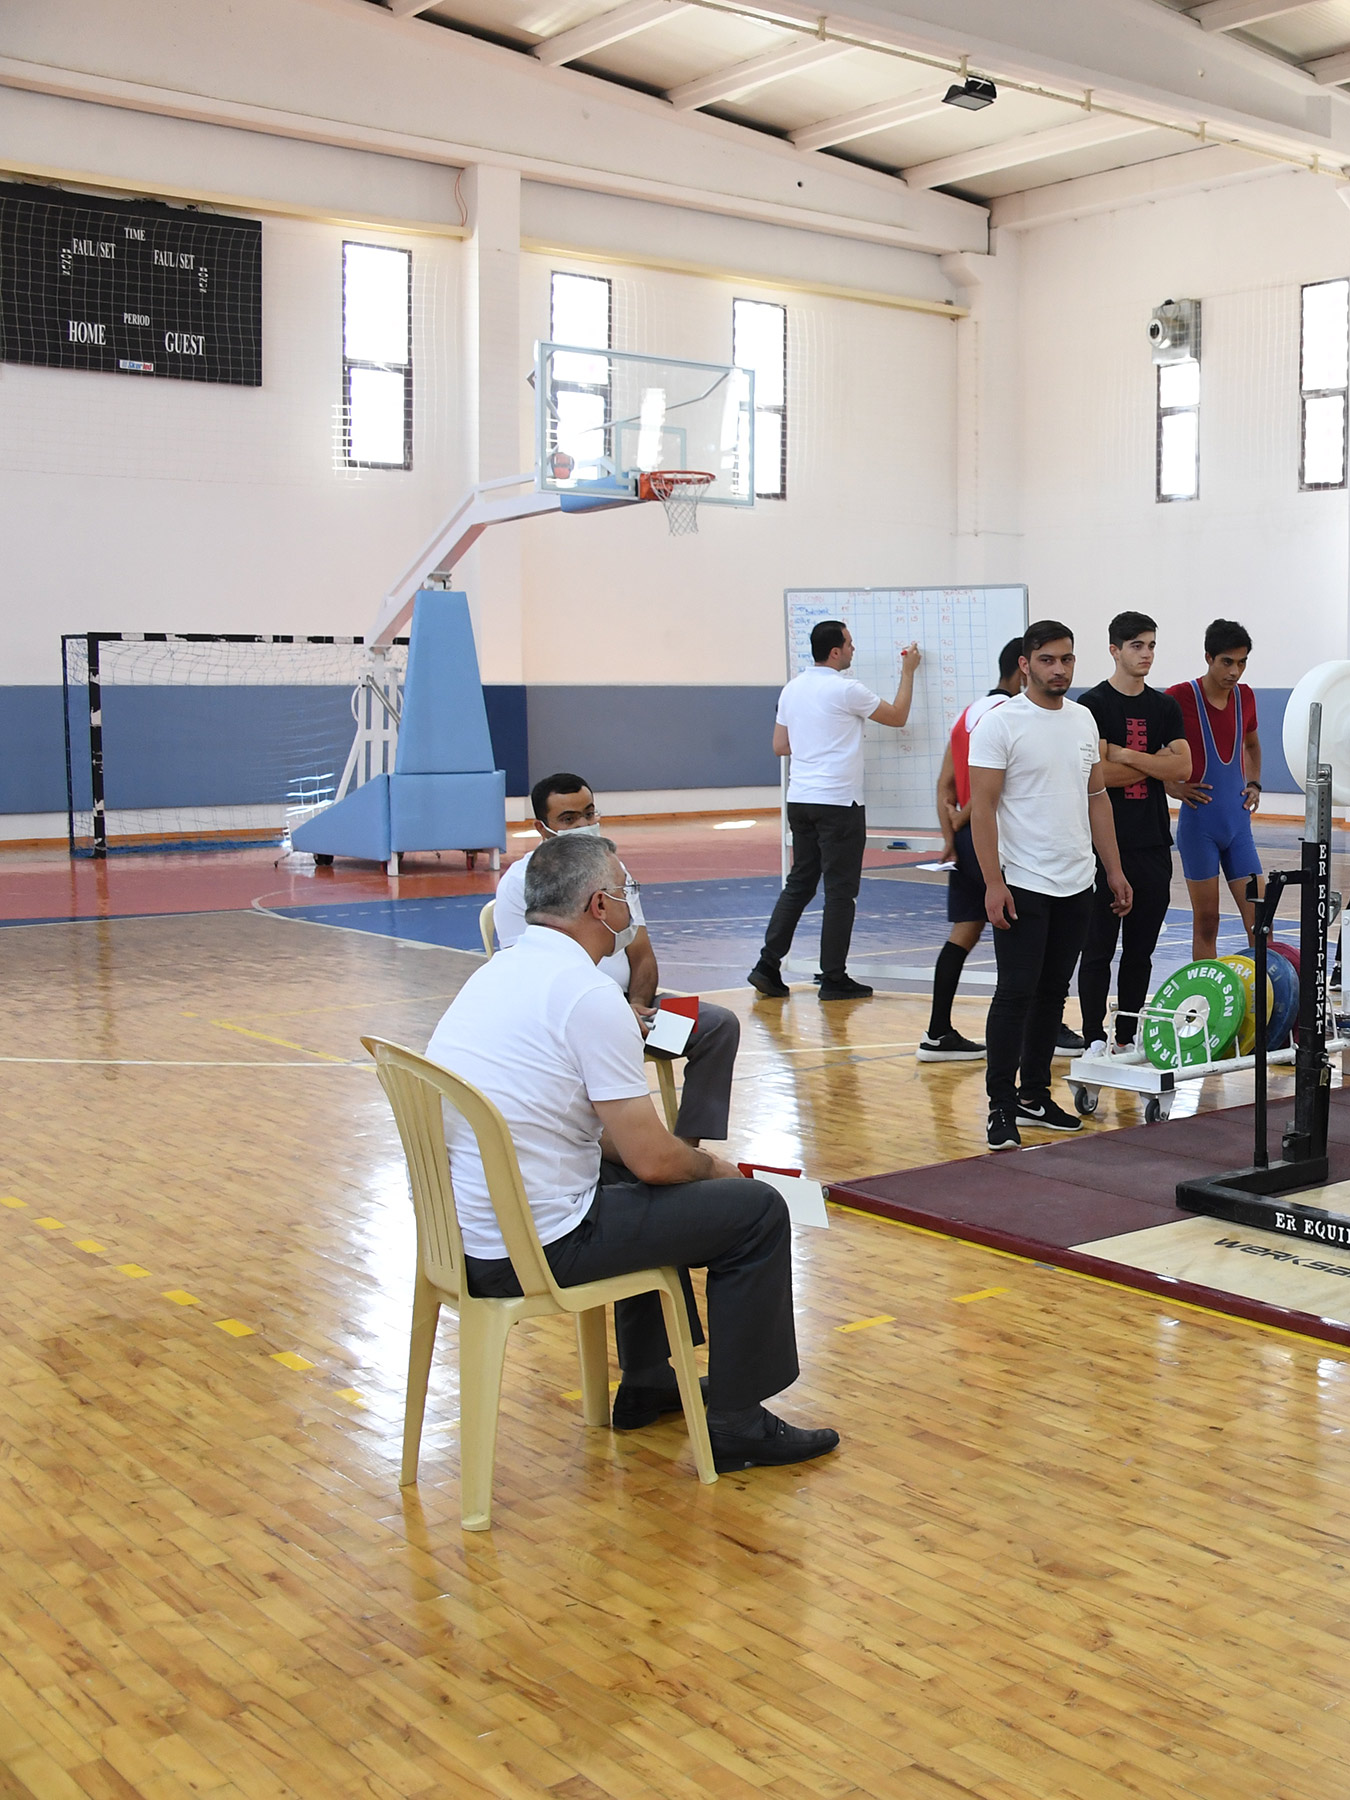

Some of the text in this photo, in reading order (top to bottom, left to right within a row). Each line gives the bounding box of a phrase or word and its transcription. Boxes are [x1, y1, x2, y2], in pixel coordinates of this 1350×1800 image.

[124, 228, 146, 242] TIME
[124, 312, 150, 326] PERIOD
[68, 320, 106, 345] HOME
[165, 331, 206, 356] GUEST
[1318, 844, 1328, 876] ER
[1186, 966, 1234, 1018] WERK SAN
[1275, 1212, 1298, 1232] ER
